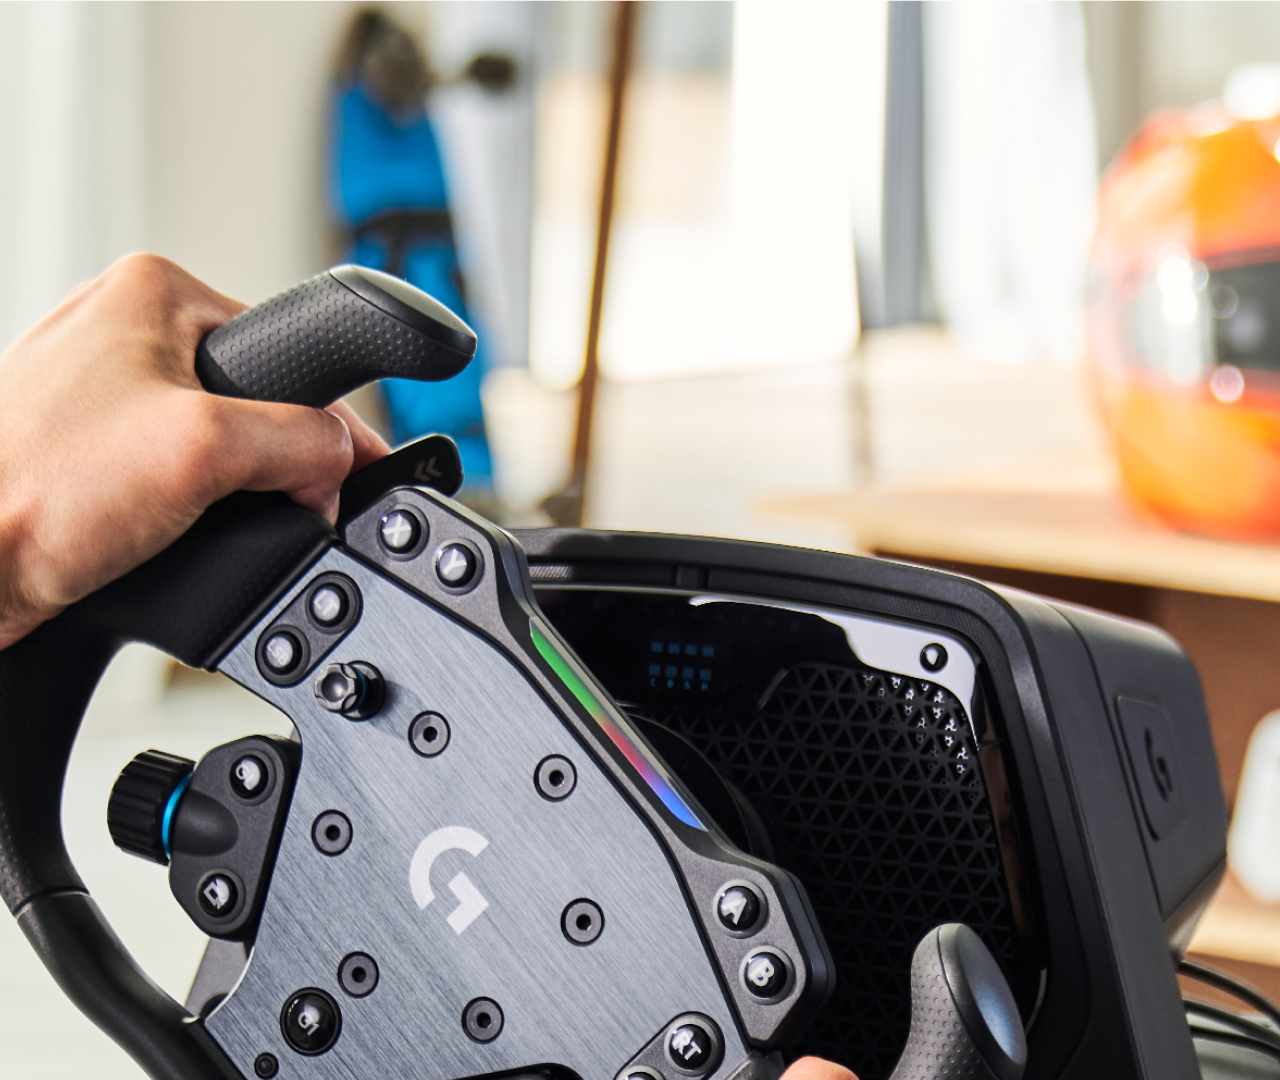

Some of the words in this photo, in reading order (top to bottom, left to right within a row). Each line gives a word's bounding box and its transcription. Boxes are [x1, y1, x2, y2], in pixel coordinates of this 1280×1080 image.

[382, 514, 412, 548] X
[442, 548, 468, 576] Y
[313, 590, 340, 616] LT
[266, 639, 290, 666] LSB
[409, 825, 490, 935] G
[721, 897, 748, 926] A
[749, 958, 775, 988] B
[298, 1012, 320, 1036] G1
[672, 1030, 702, 1061] RT
